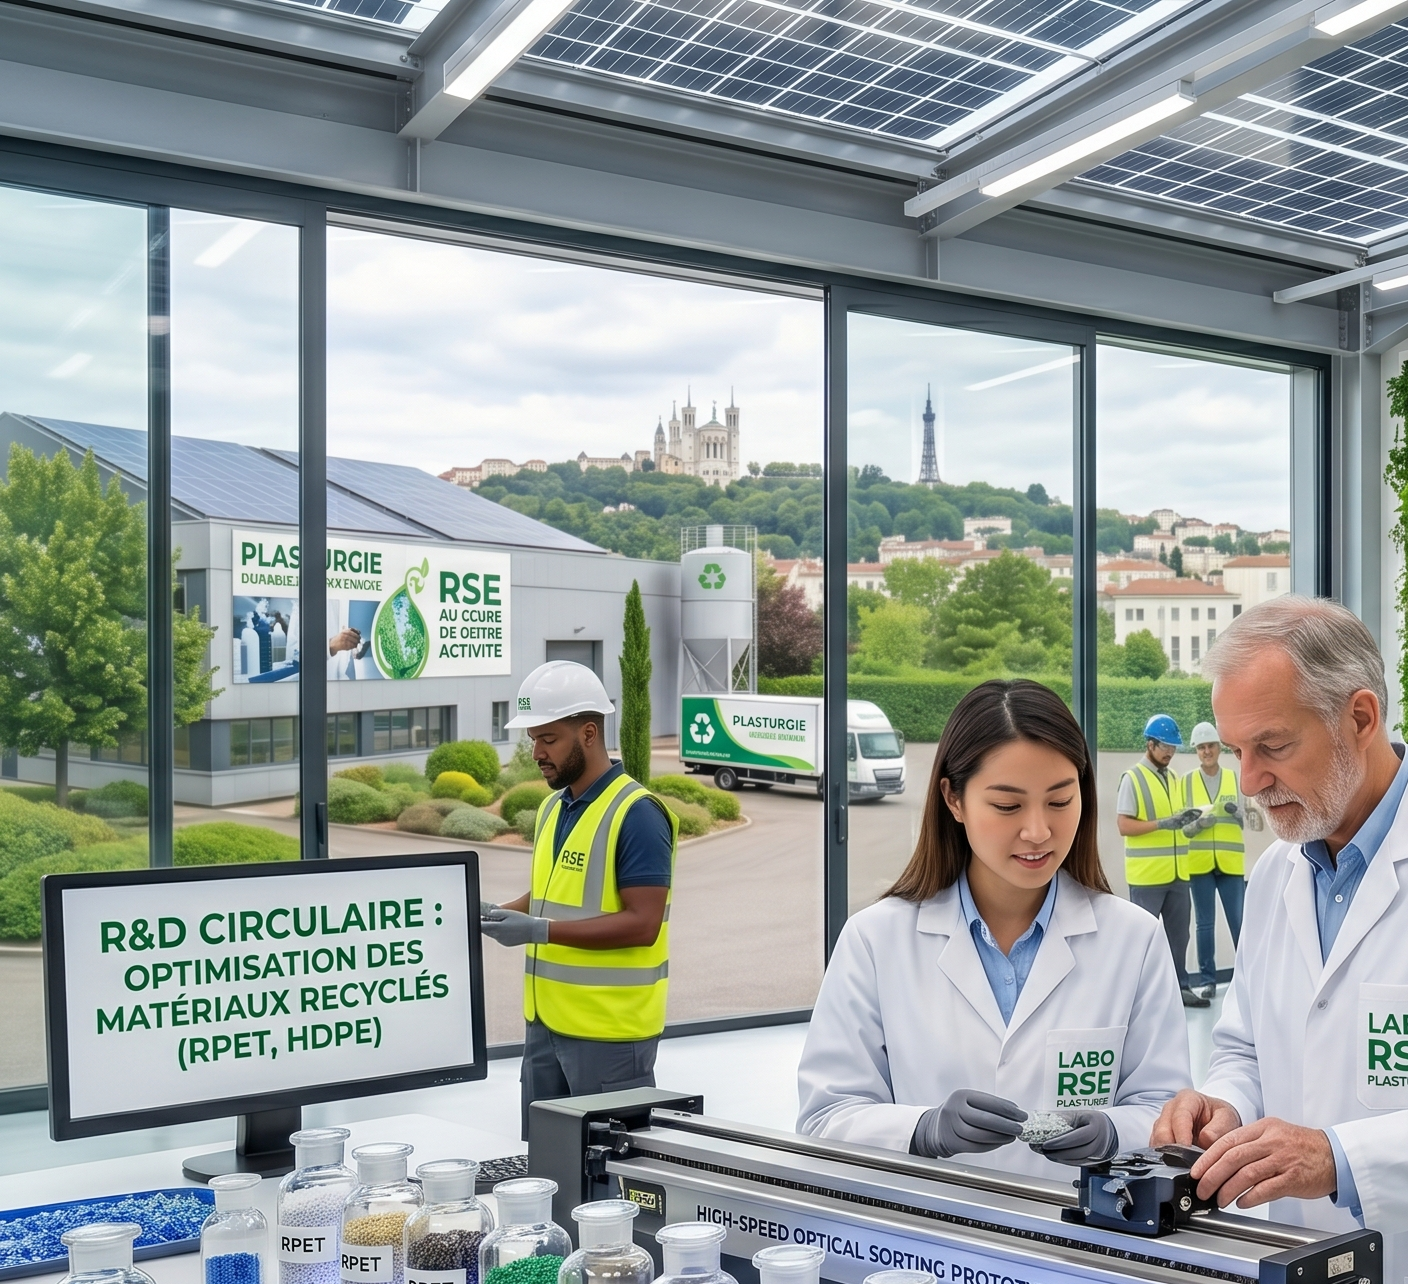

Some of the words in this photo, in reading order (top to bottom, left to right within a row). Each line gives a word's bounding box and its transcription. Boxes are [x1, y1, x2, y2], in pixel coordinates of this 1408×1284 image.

[439, 570, 502, 606] RSE
[439, 608, 458, 622] AU
[439, 626, 457, 639] DE
[439, 643, 502, 658] ACTIVITE
[732, 715, 806, 731] PLASTURGIE
[561, 850, 585, 867] RSE
[100, 916, 186, 953] R&D
[199, 898, 424, 945] CIRCULAIRE
[124, 945, 356, 992] OPTIMISATION
[366, 939, 424, 969] DES
[97, 989, 291, 1035] MATÉRIAUX
[300, 969, 450, 1013] RECYCLÉS
[178, 1030, 279, 1071] (RPET,
[287, 1016, 382, 1051] HDPE)
[1058, 1050, 1115, 1069] LABO
[1057, 1070, 1112, 1096] RSE
[281, 1236, 326, 1253] RPET
[696, 1205, 790, 1242] HIGH-SPEED
[793, 1228, 865, 1261] OPTICAL
[869, 1244, 945, 1279] SORTING
[341, 1254, 382, 1272] RPET
